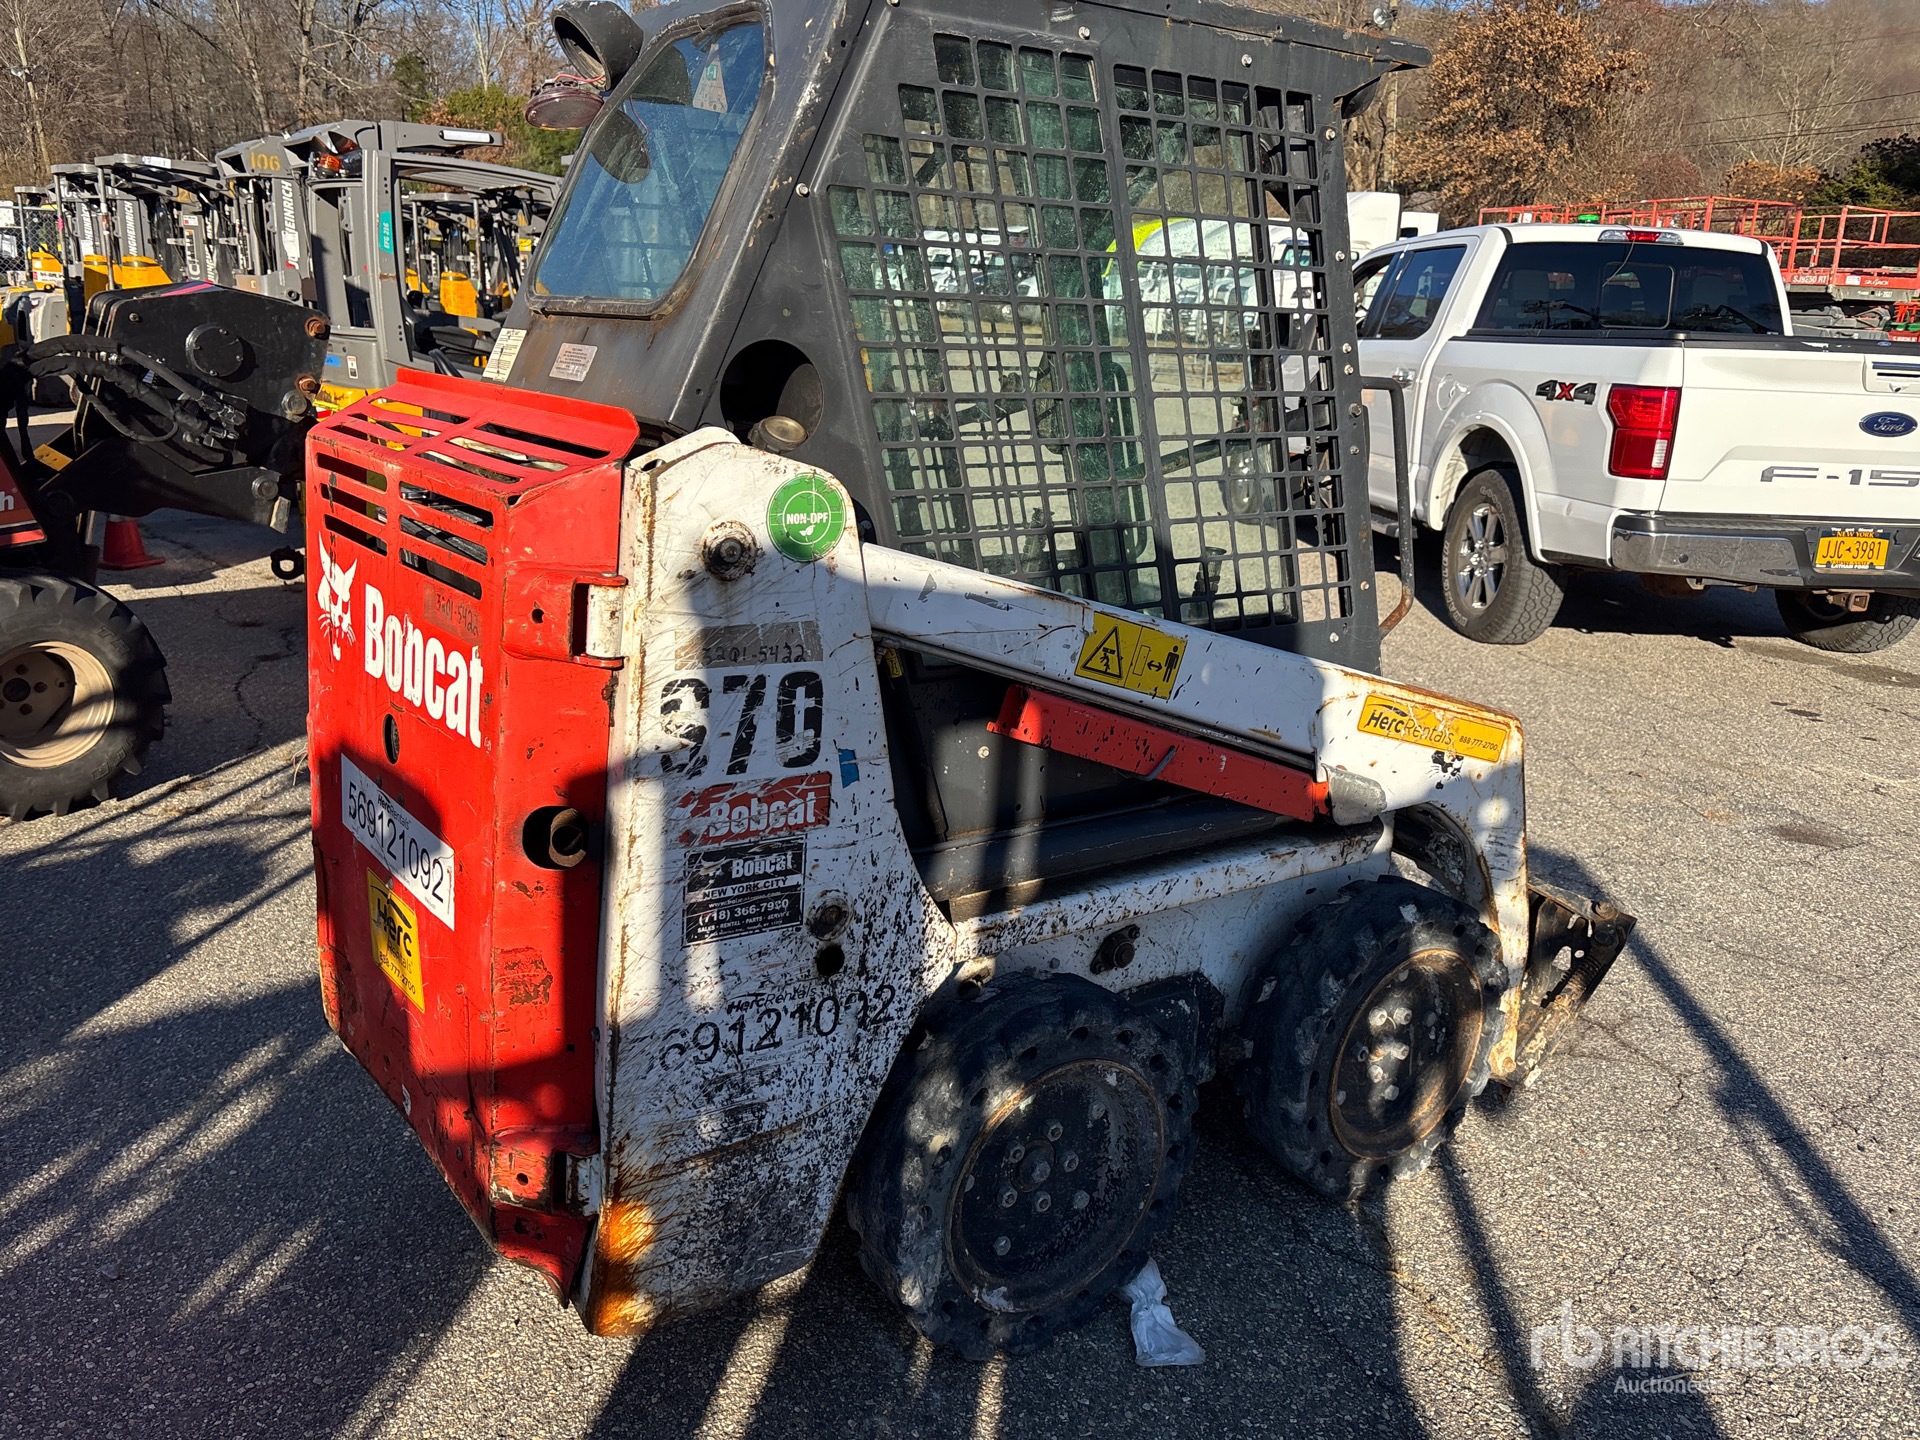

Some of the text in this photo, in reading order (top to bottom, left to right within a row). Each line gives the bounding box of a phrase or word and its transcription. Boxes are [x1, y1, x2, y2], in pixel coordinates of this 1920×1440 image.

[1874, 416, 1906, 432] Ford
[786, 512, 828, 524] NON-DPF
[1822, 540, 1881, 560] JJC 3981
[364, 583, 484, 748] Bobcat
[1459, 735, 1498, 751] 888-777-2700
[708, 791, 817, 838] Bobcat
[349, 781, 444, 904] 569121092
[731, 851, 793, 879] Bobcat
[703, 887, 727, 900] NEW
[731, 883, 761, 896] YORK
[763, 877, 788, 889] CITY
[377, 898, 412, 957] Herc
[699, 909, 731, 926] (718)
